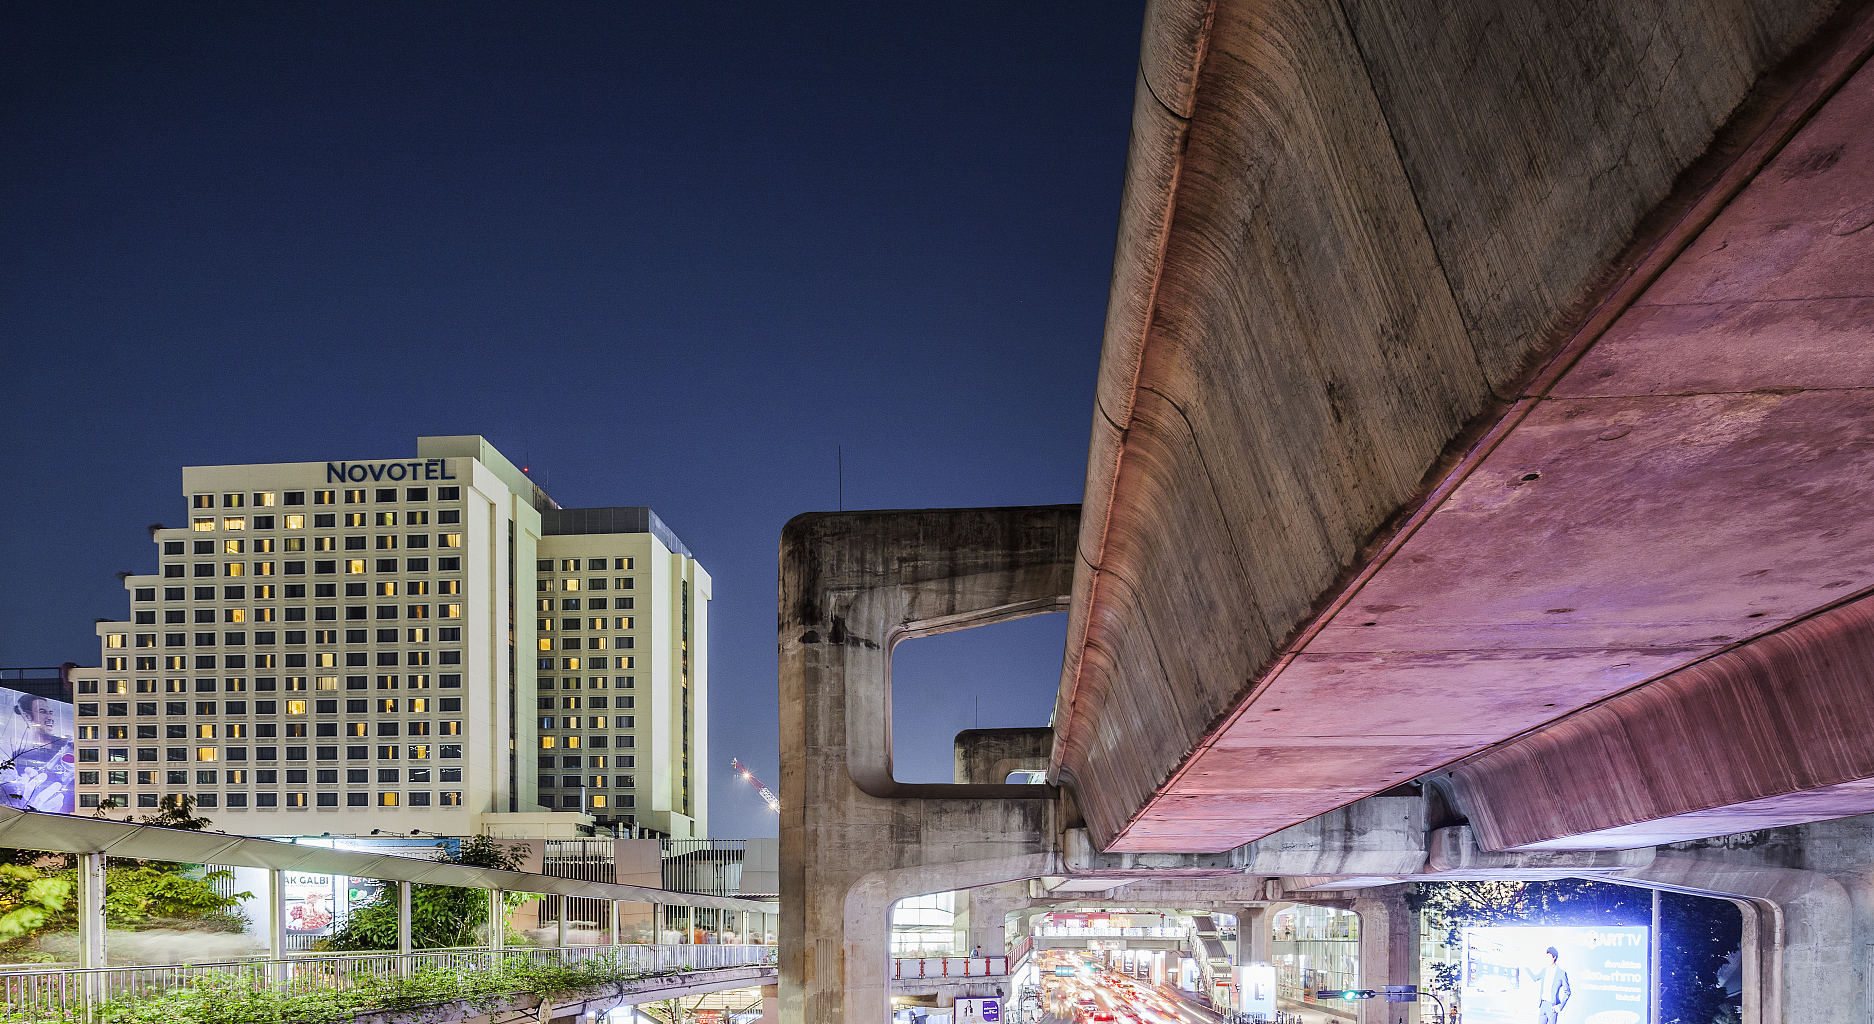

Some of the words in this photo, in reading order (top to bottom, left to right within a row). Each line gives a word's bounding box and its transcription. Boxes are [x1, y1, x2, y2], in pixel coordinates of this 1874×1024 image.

[326, 458, 456, 483] NOVOTEL
[299, 876, 329, 885] GALBI
[1626, 932, 1642, 947] TV
